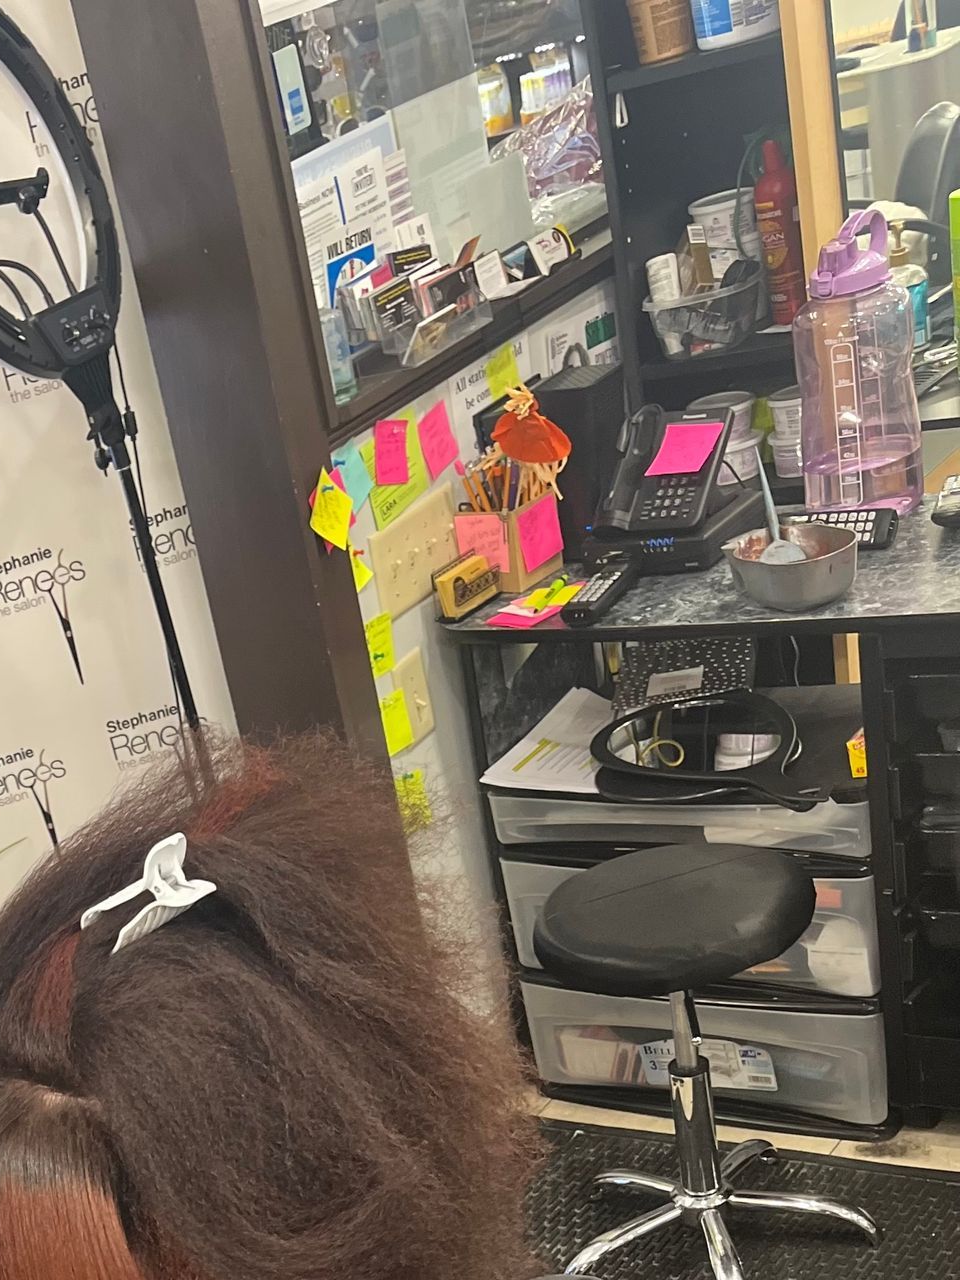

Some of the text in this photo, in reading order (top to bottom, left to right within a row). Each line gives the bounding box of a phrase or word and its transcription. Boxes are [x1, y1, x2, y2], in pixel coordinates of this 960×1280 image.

[326, 227, 372, 260] WILL RETURN
[10, 388, 31, 404] the
[163, 548, 197, 566] salon
[13, 594, 47, 613] salon
[106, 704, 178, 733] Stephanie
[117, 757, 137, 771] the
